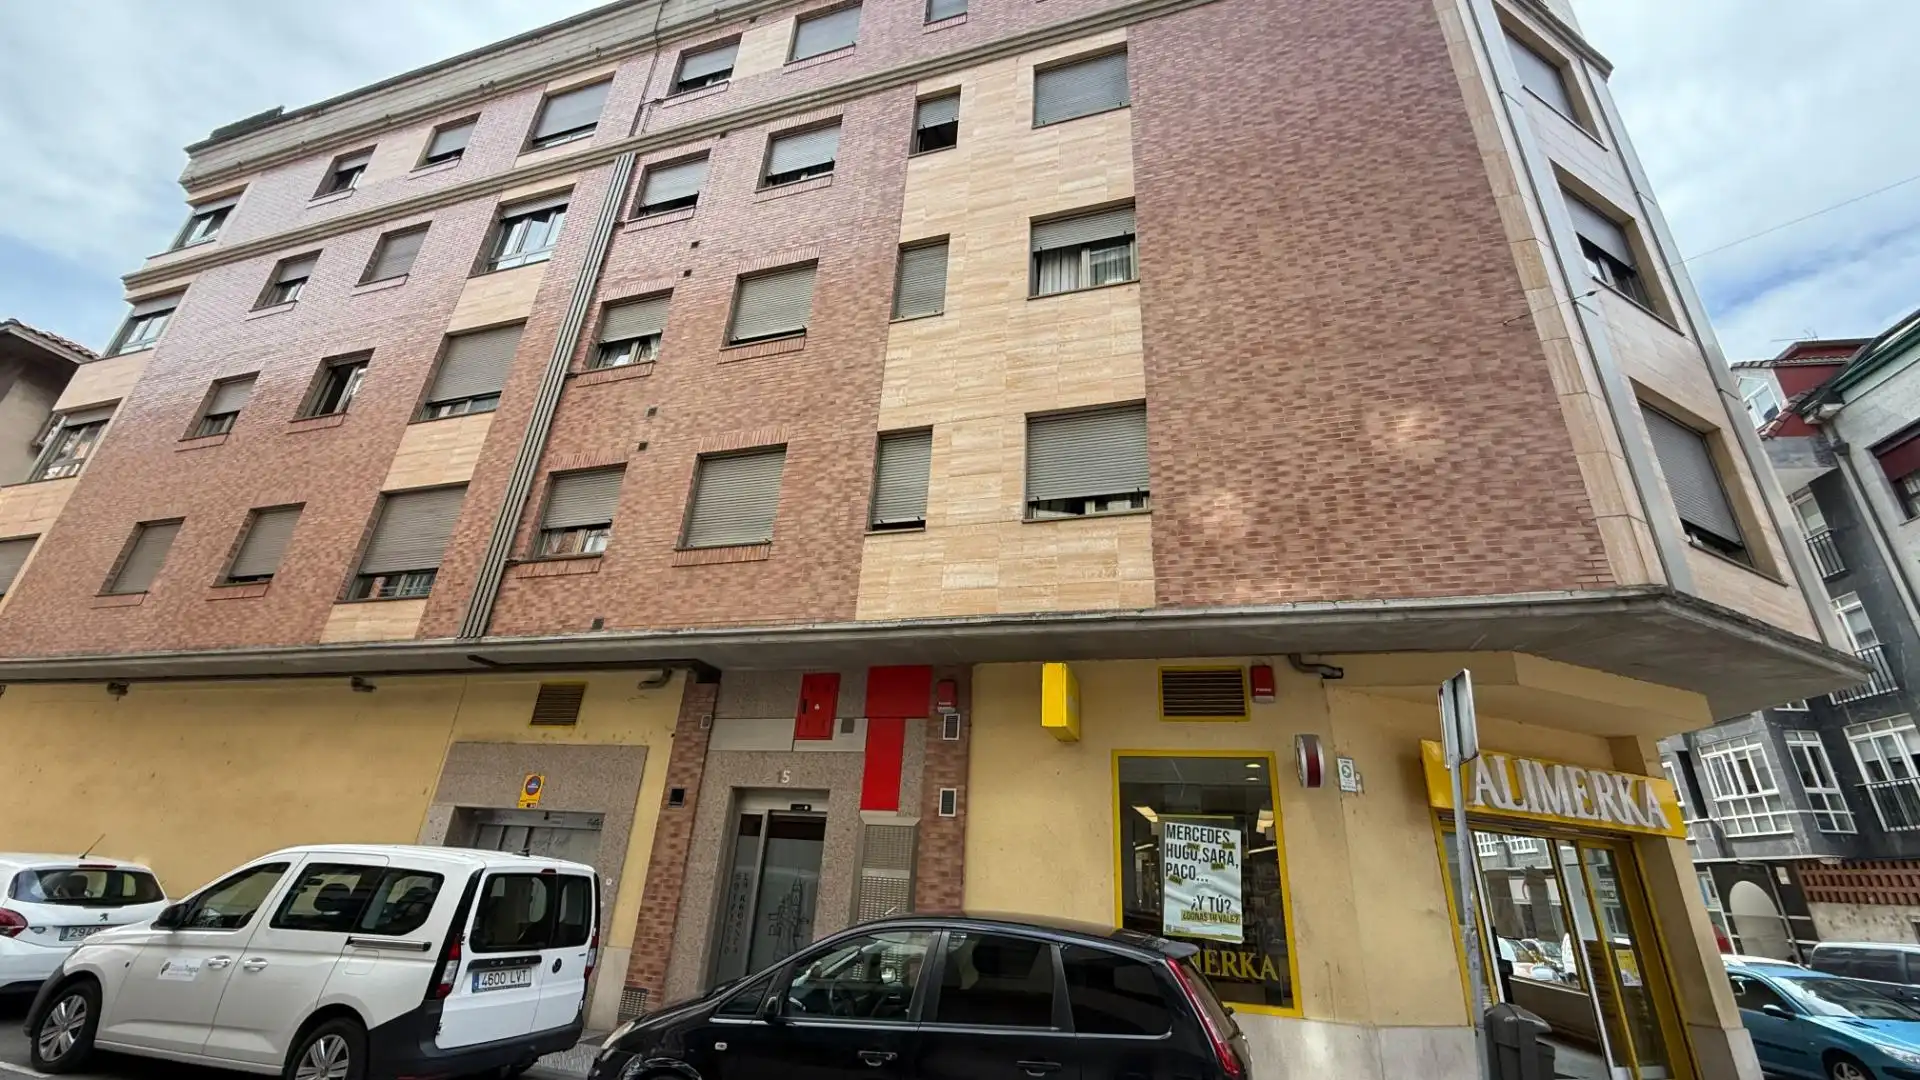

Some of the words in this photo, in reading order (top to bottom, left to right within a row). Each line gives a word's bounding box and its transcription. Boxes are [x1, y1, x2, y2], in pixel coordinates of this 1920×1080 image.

[781, 769, 792, 784] 5
[1472, 754, 1672, 831] ALIMERKA
[481, 971, 507, 987] 4600
[510, 969, 528, 984] LVT
